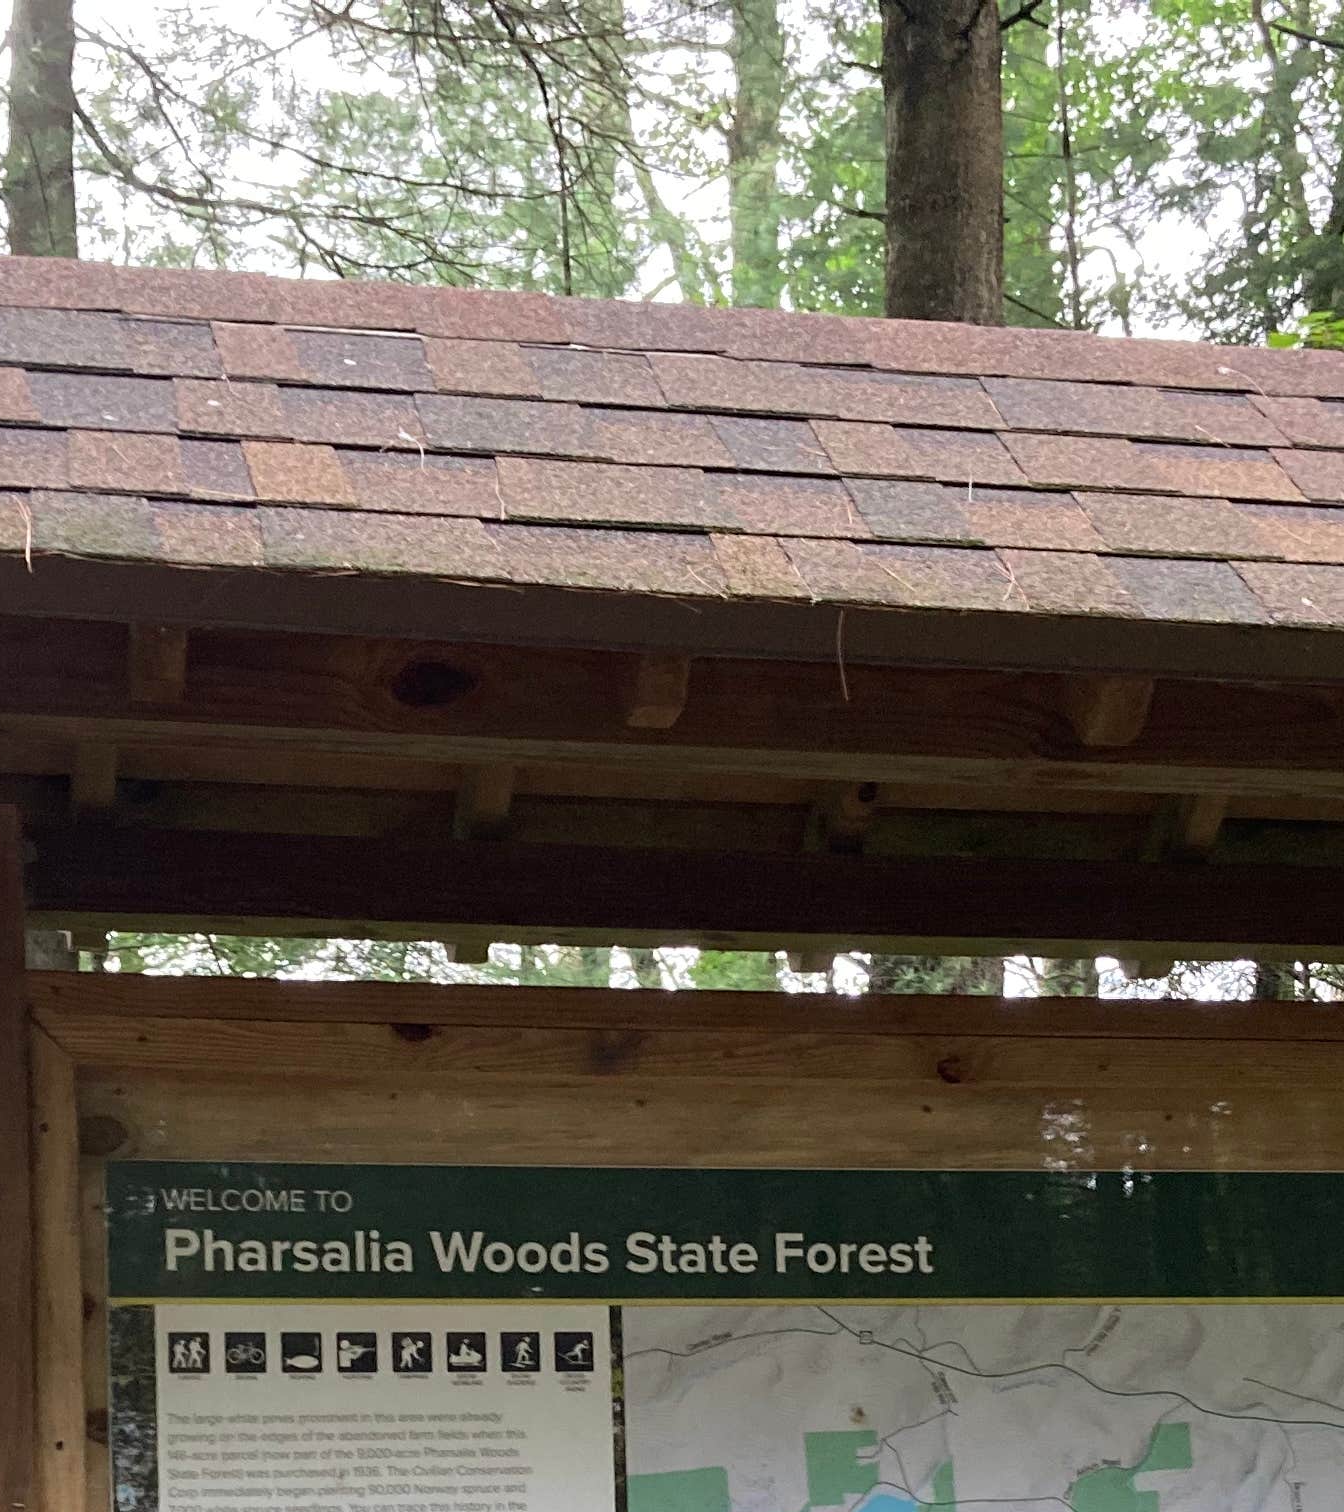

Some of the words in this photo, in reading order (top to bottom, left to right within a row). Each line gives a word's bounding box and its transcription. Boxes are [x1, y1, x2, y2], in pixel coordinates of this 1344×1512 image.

[162, 1188, 305, 1212] WELCOME
[315, 1190, 353, 1213] TO
[164, 1228, 413, 1273] Pharsalia
[428, 1230, 610, 1274] Woods
[625, 1231, 758, 1274] State
[775, 1232, 934, 1274] Forest
